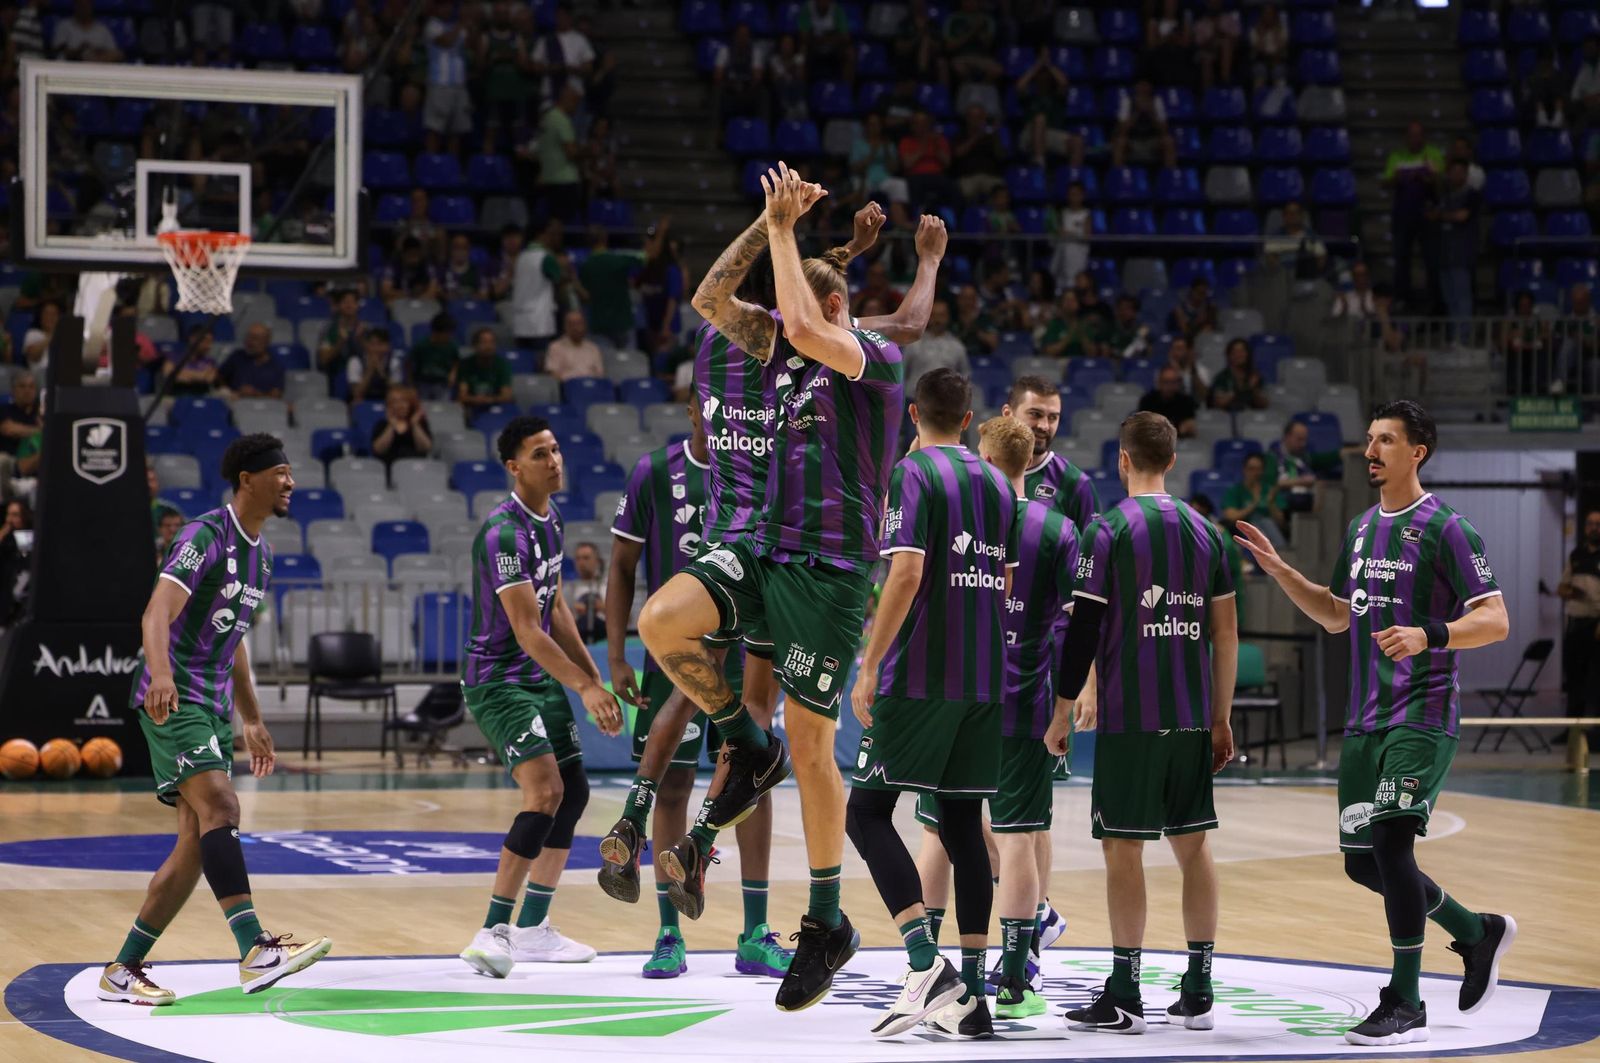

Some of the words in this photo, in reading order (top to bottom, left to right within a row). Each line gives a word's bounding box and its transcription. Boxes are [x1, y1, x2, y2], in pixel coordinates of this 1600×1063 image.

[722, 406, 775, 424] Unicaja
[1365, 558, 1413, 572] Fundación
[1364, 568, 1396, 582] Unicaja
[784, 653, 812, 677] laga
[792, 650, 817, 668] má
[1006, 926, 1018, 952] UNICAJA
